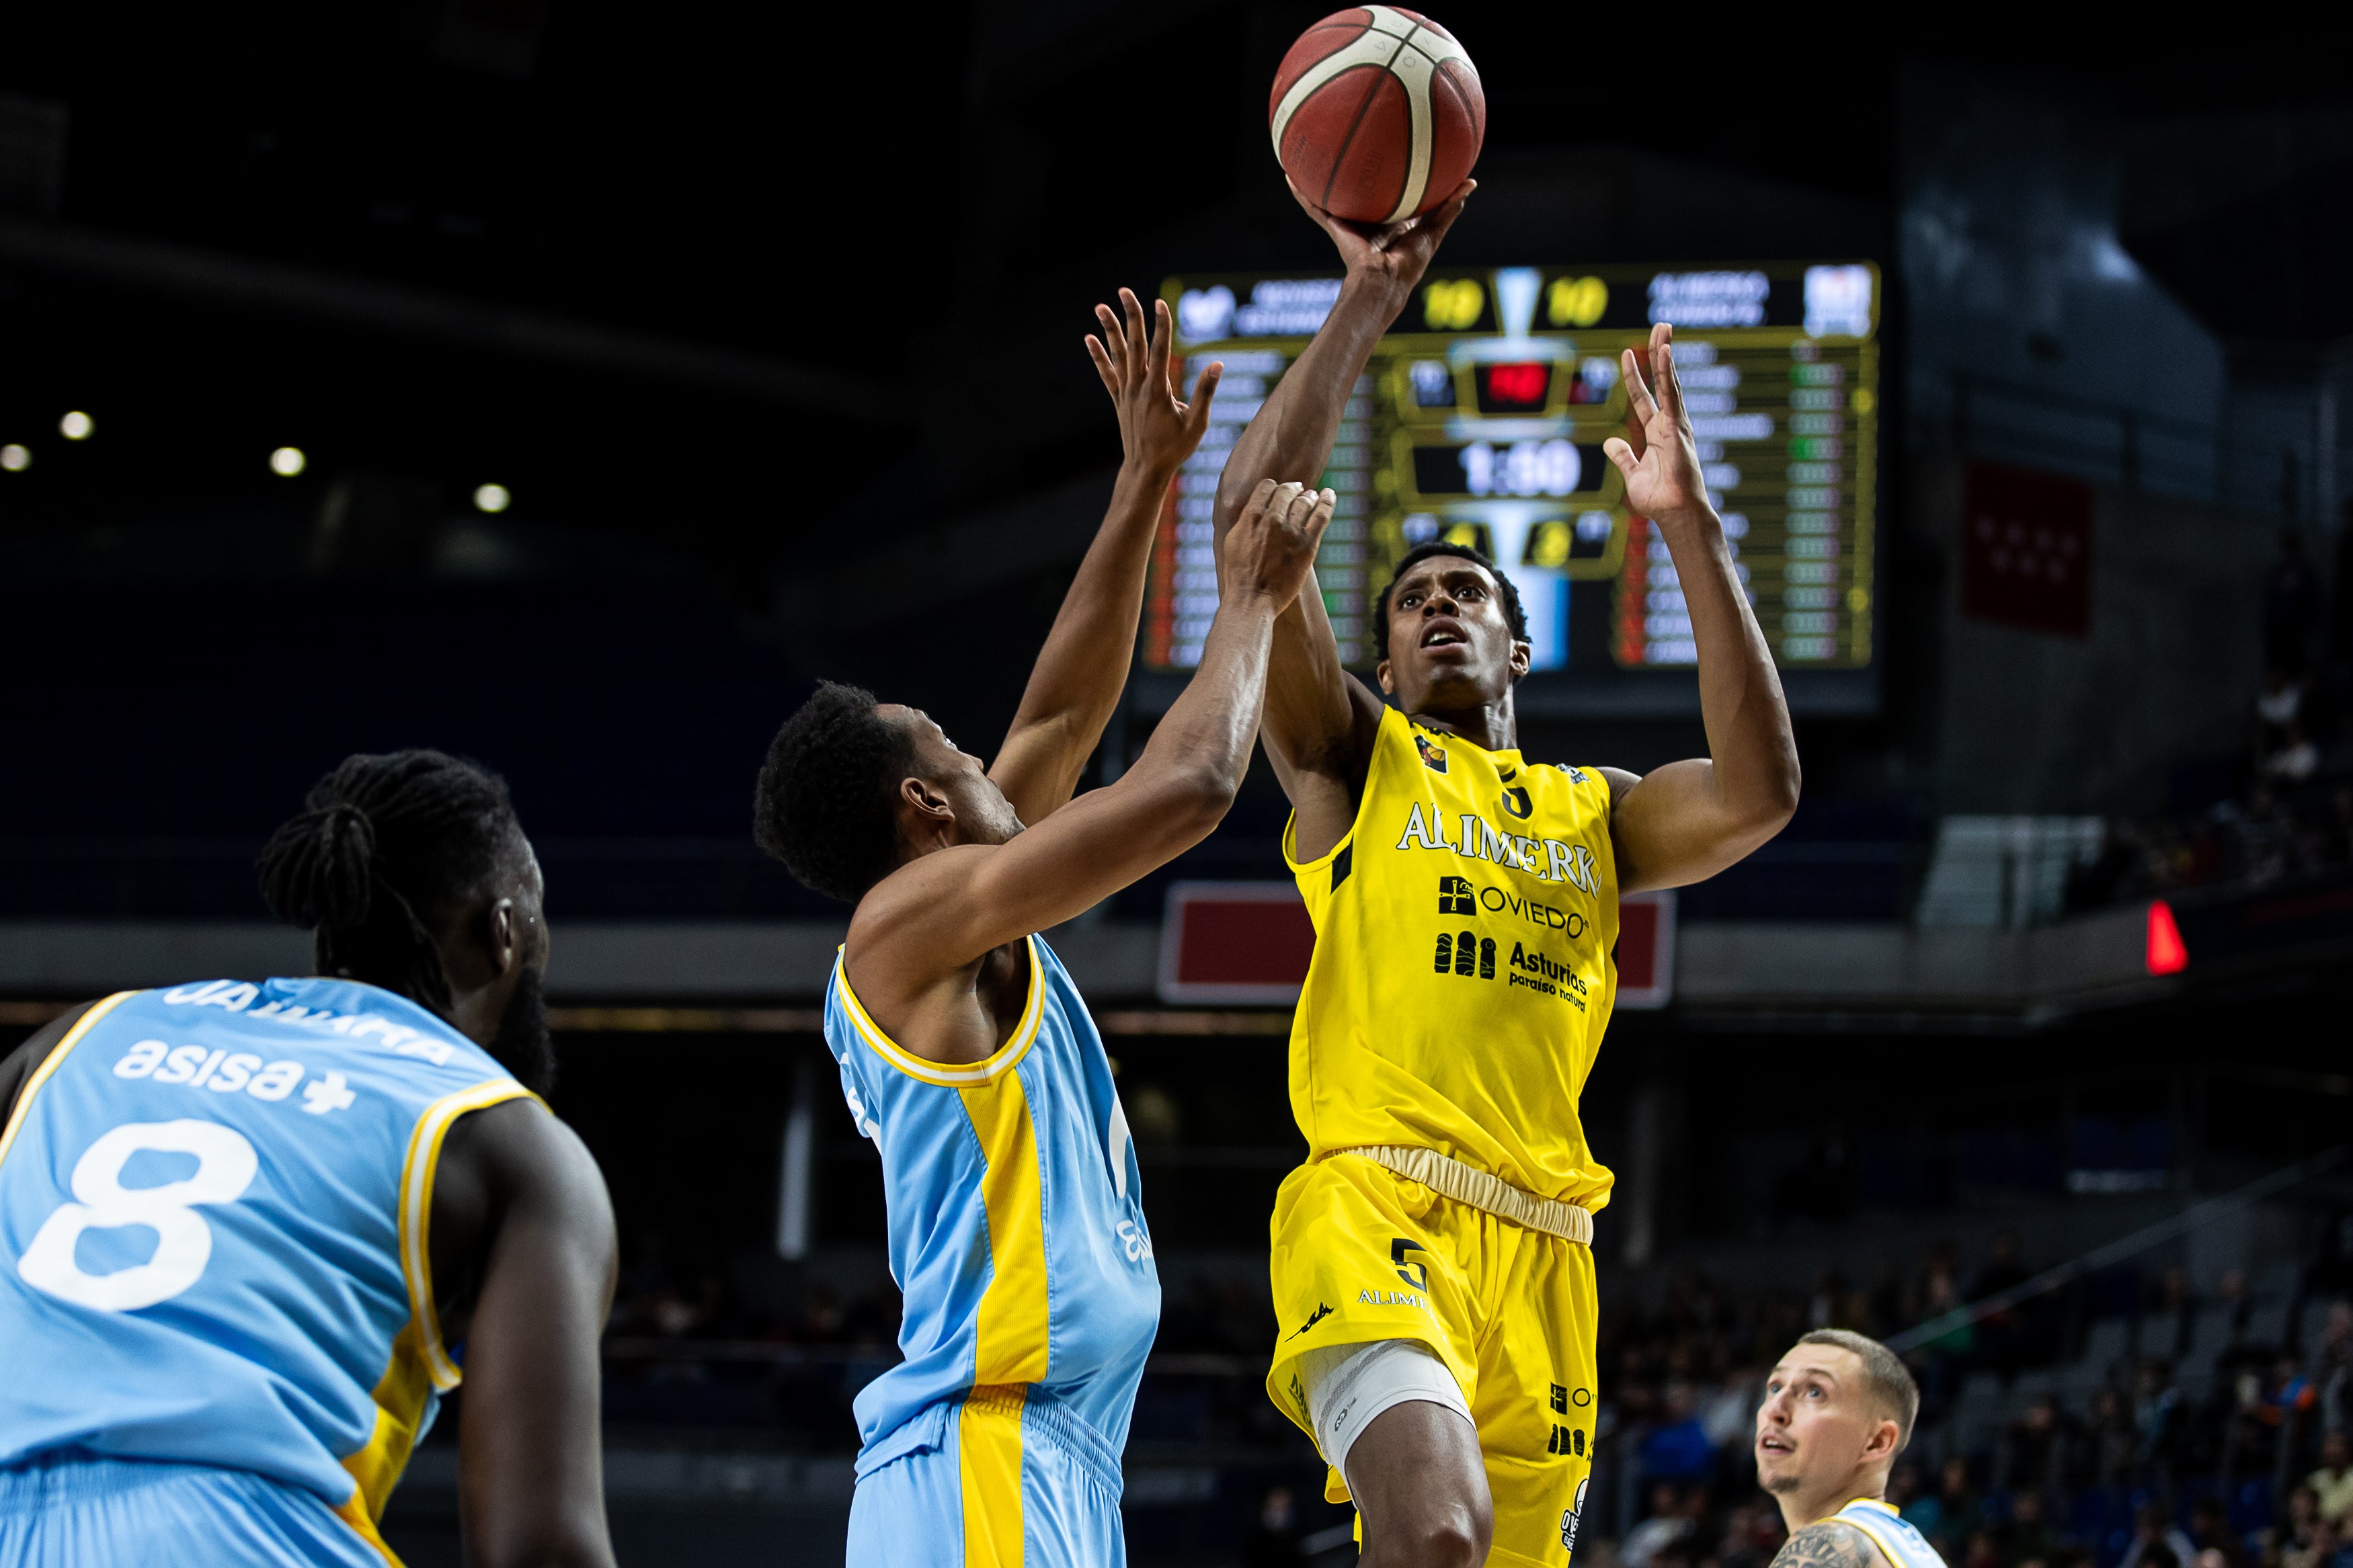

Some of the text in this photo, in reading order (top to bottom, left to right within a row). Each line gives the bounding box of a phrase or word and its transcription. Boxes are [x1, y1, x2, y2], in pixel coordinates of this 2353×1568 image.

[1396, 801, 1602, 900] ALIMERK
[1509, 941, 1587, 996] Asturias
[1509, 971, 1586, 1014] paraíso natural
[113, 1040, 305, 1101] asisa
[17, 1119, 258, 1313] 8
[1391, 1238, 1427, 1294] 5
